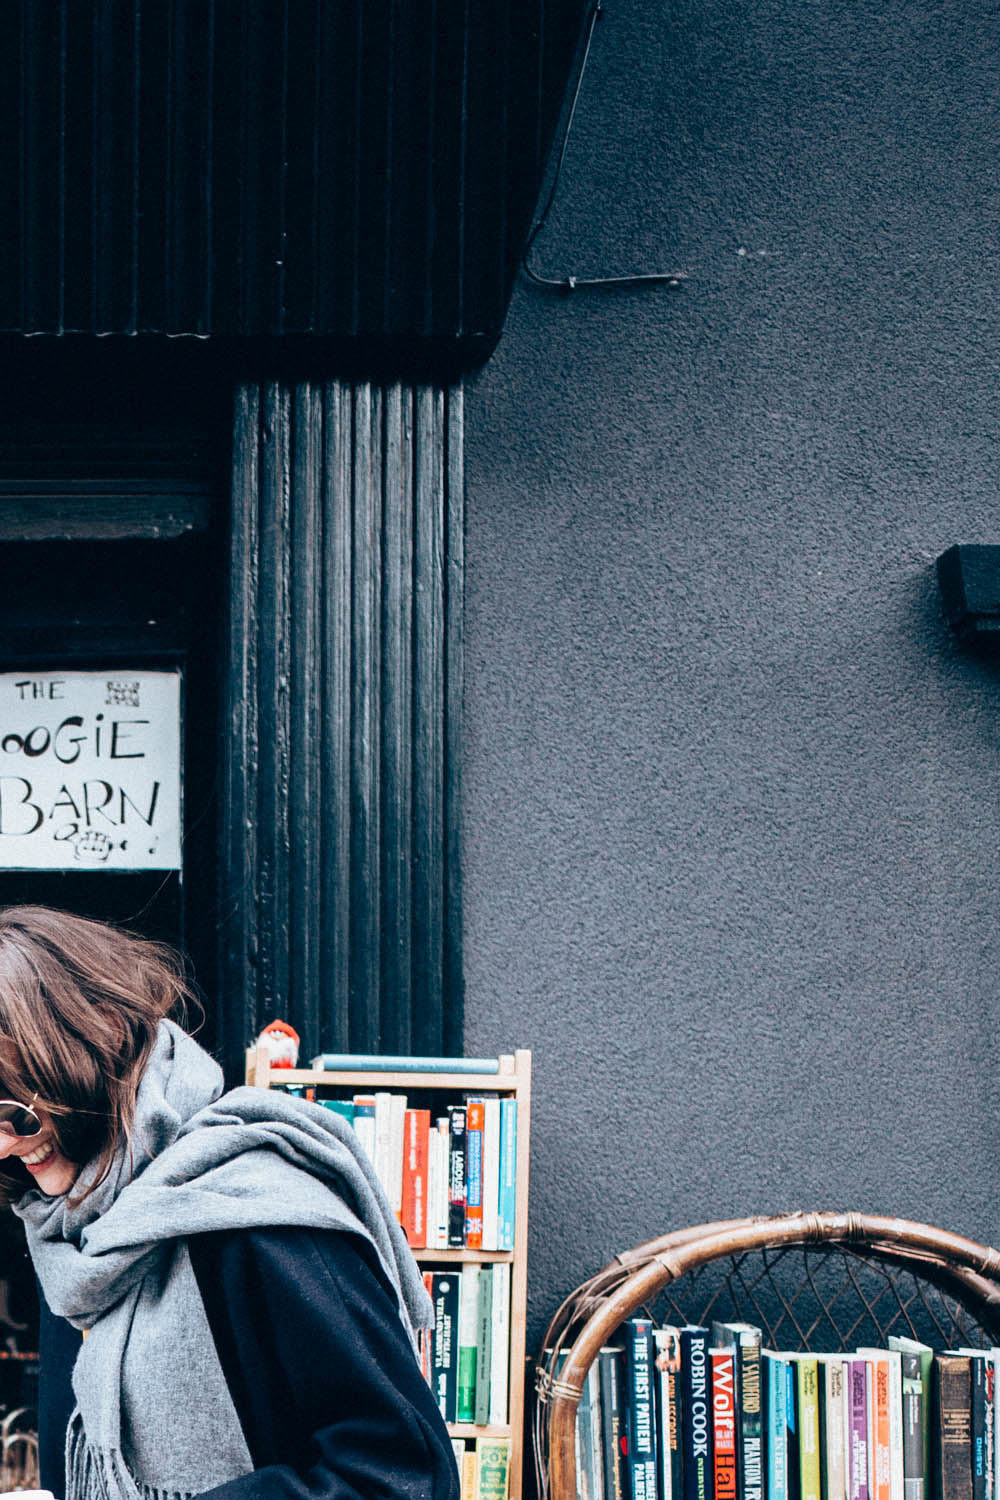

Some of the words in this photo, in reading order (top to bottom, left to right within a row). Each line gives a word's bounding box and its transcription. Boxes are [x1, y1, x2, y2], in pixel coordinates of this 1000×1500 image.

[15, 680, 65, 700] THE
[454, 1150, 464, 1202] LAROUSSE
[634, 1336, 648, 1360] THE
[691, 1338, 706, 1398] ROBIN
[634, 1363, 650, 1400] FIRST
[713, 1358, 735, 1430] Wolf
[743, 1363, 760, 1414] SANDFORD
[635, 1403, 652, 1454] PATIENT
[692, 1401, 707, 1457] COOK
[744, 1437, 761, 1485] PHANTOM
[975, 1437, 983, 1476] CASINO
